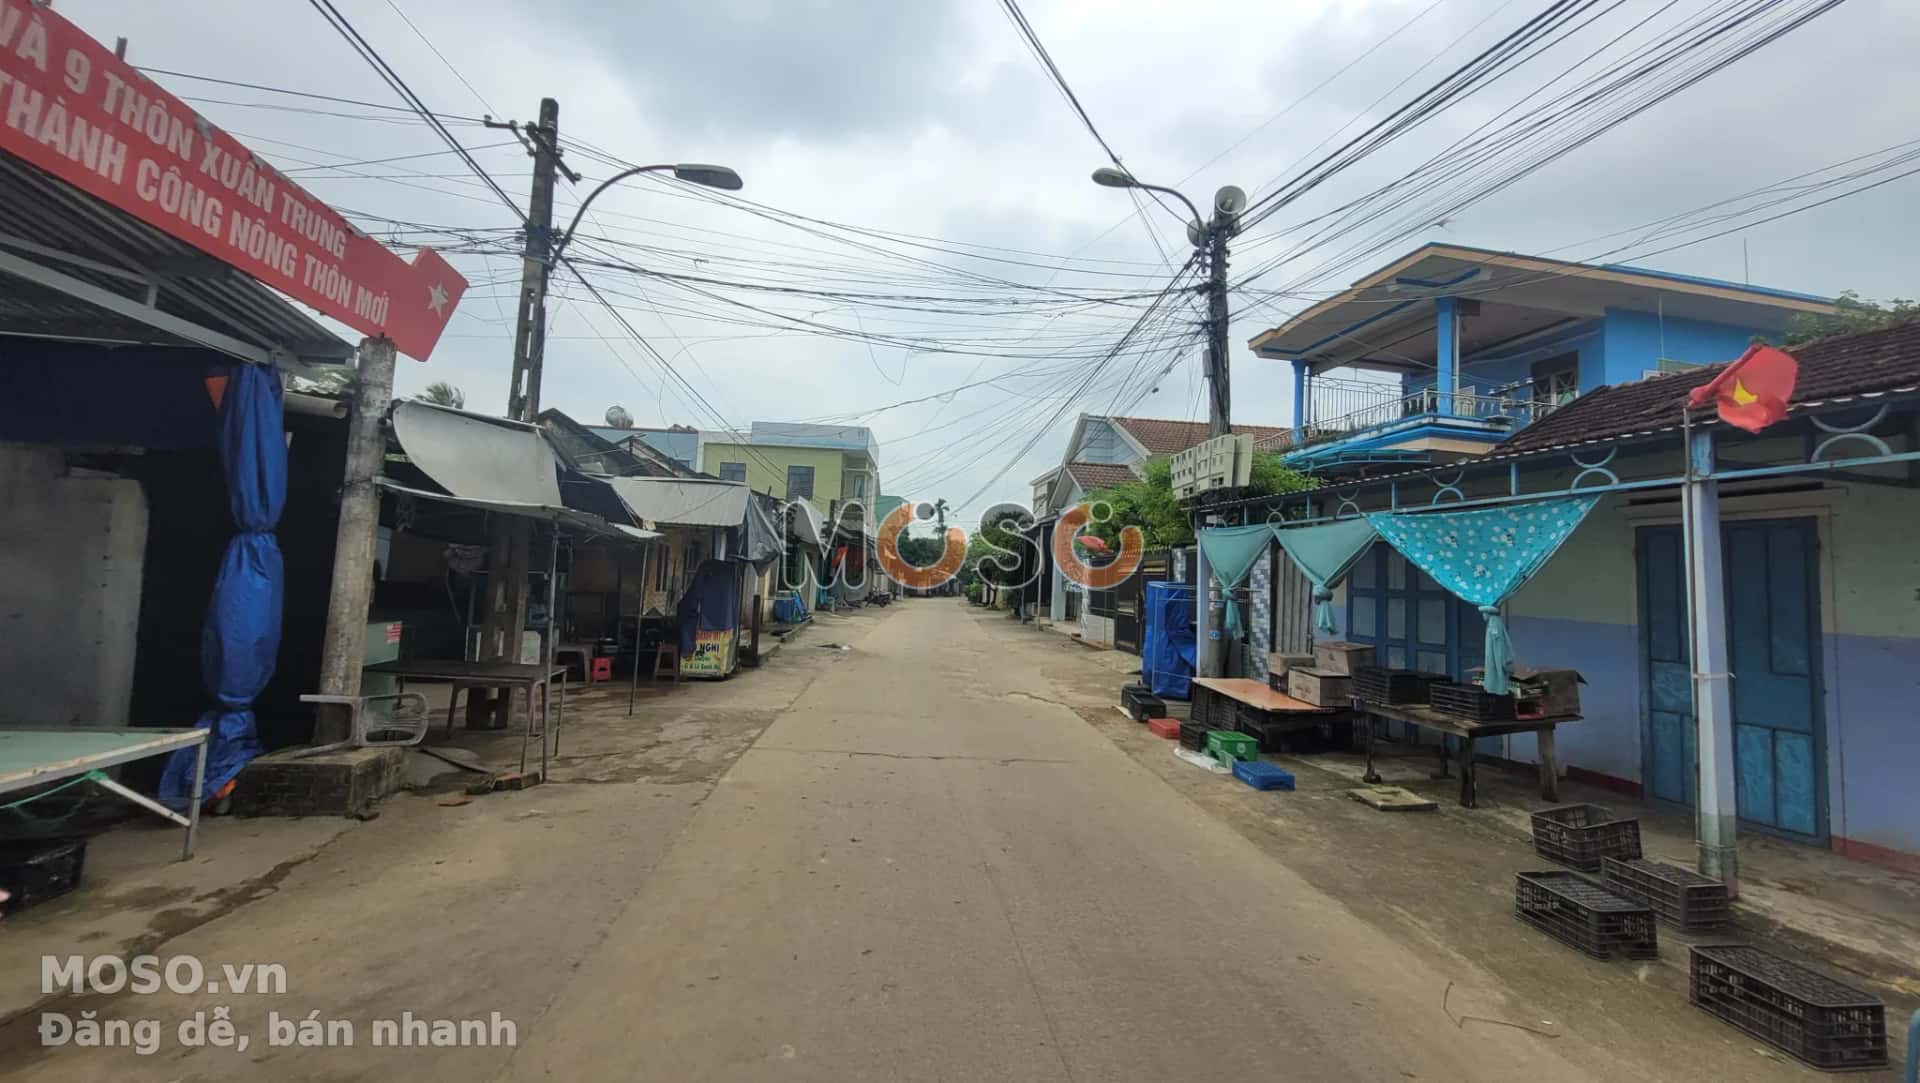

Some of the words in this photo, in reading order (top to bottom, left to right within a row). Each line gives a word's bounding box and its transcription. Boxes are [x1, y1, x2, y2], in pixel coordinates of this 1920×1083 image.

[64, 49, 91, 95] 9
[104, 70, 194, 161] THÔN
[200, 140, 275, 213] XUÂN
[281, 191, 346, 260] TRUNG
[136, 158, 224, 239] CÔNG
[229, 210, 298, 279] NÔNG
[303, 252, 353, 308] THÔN
